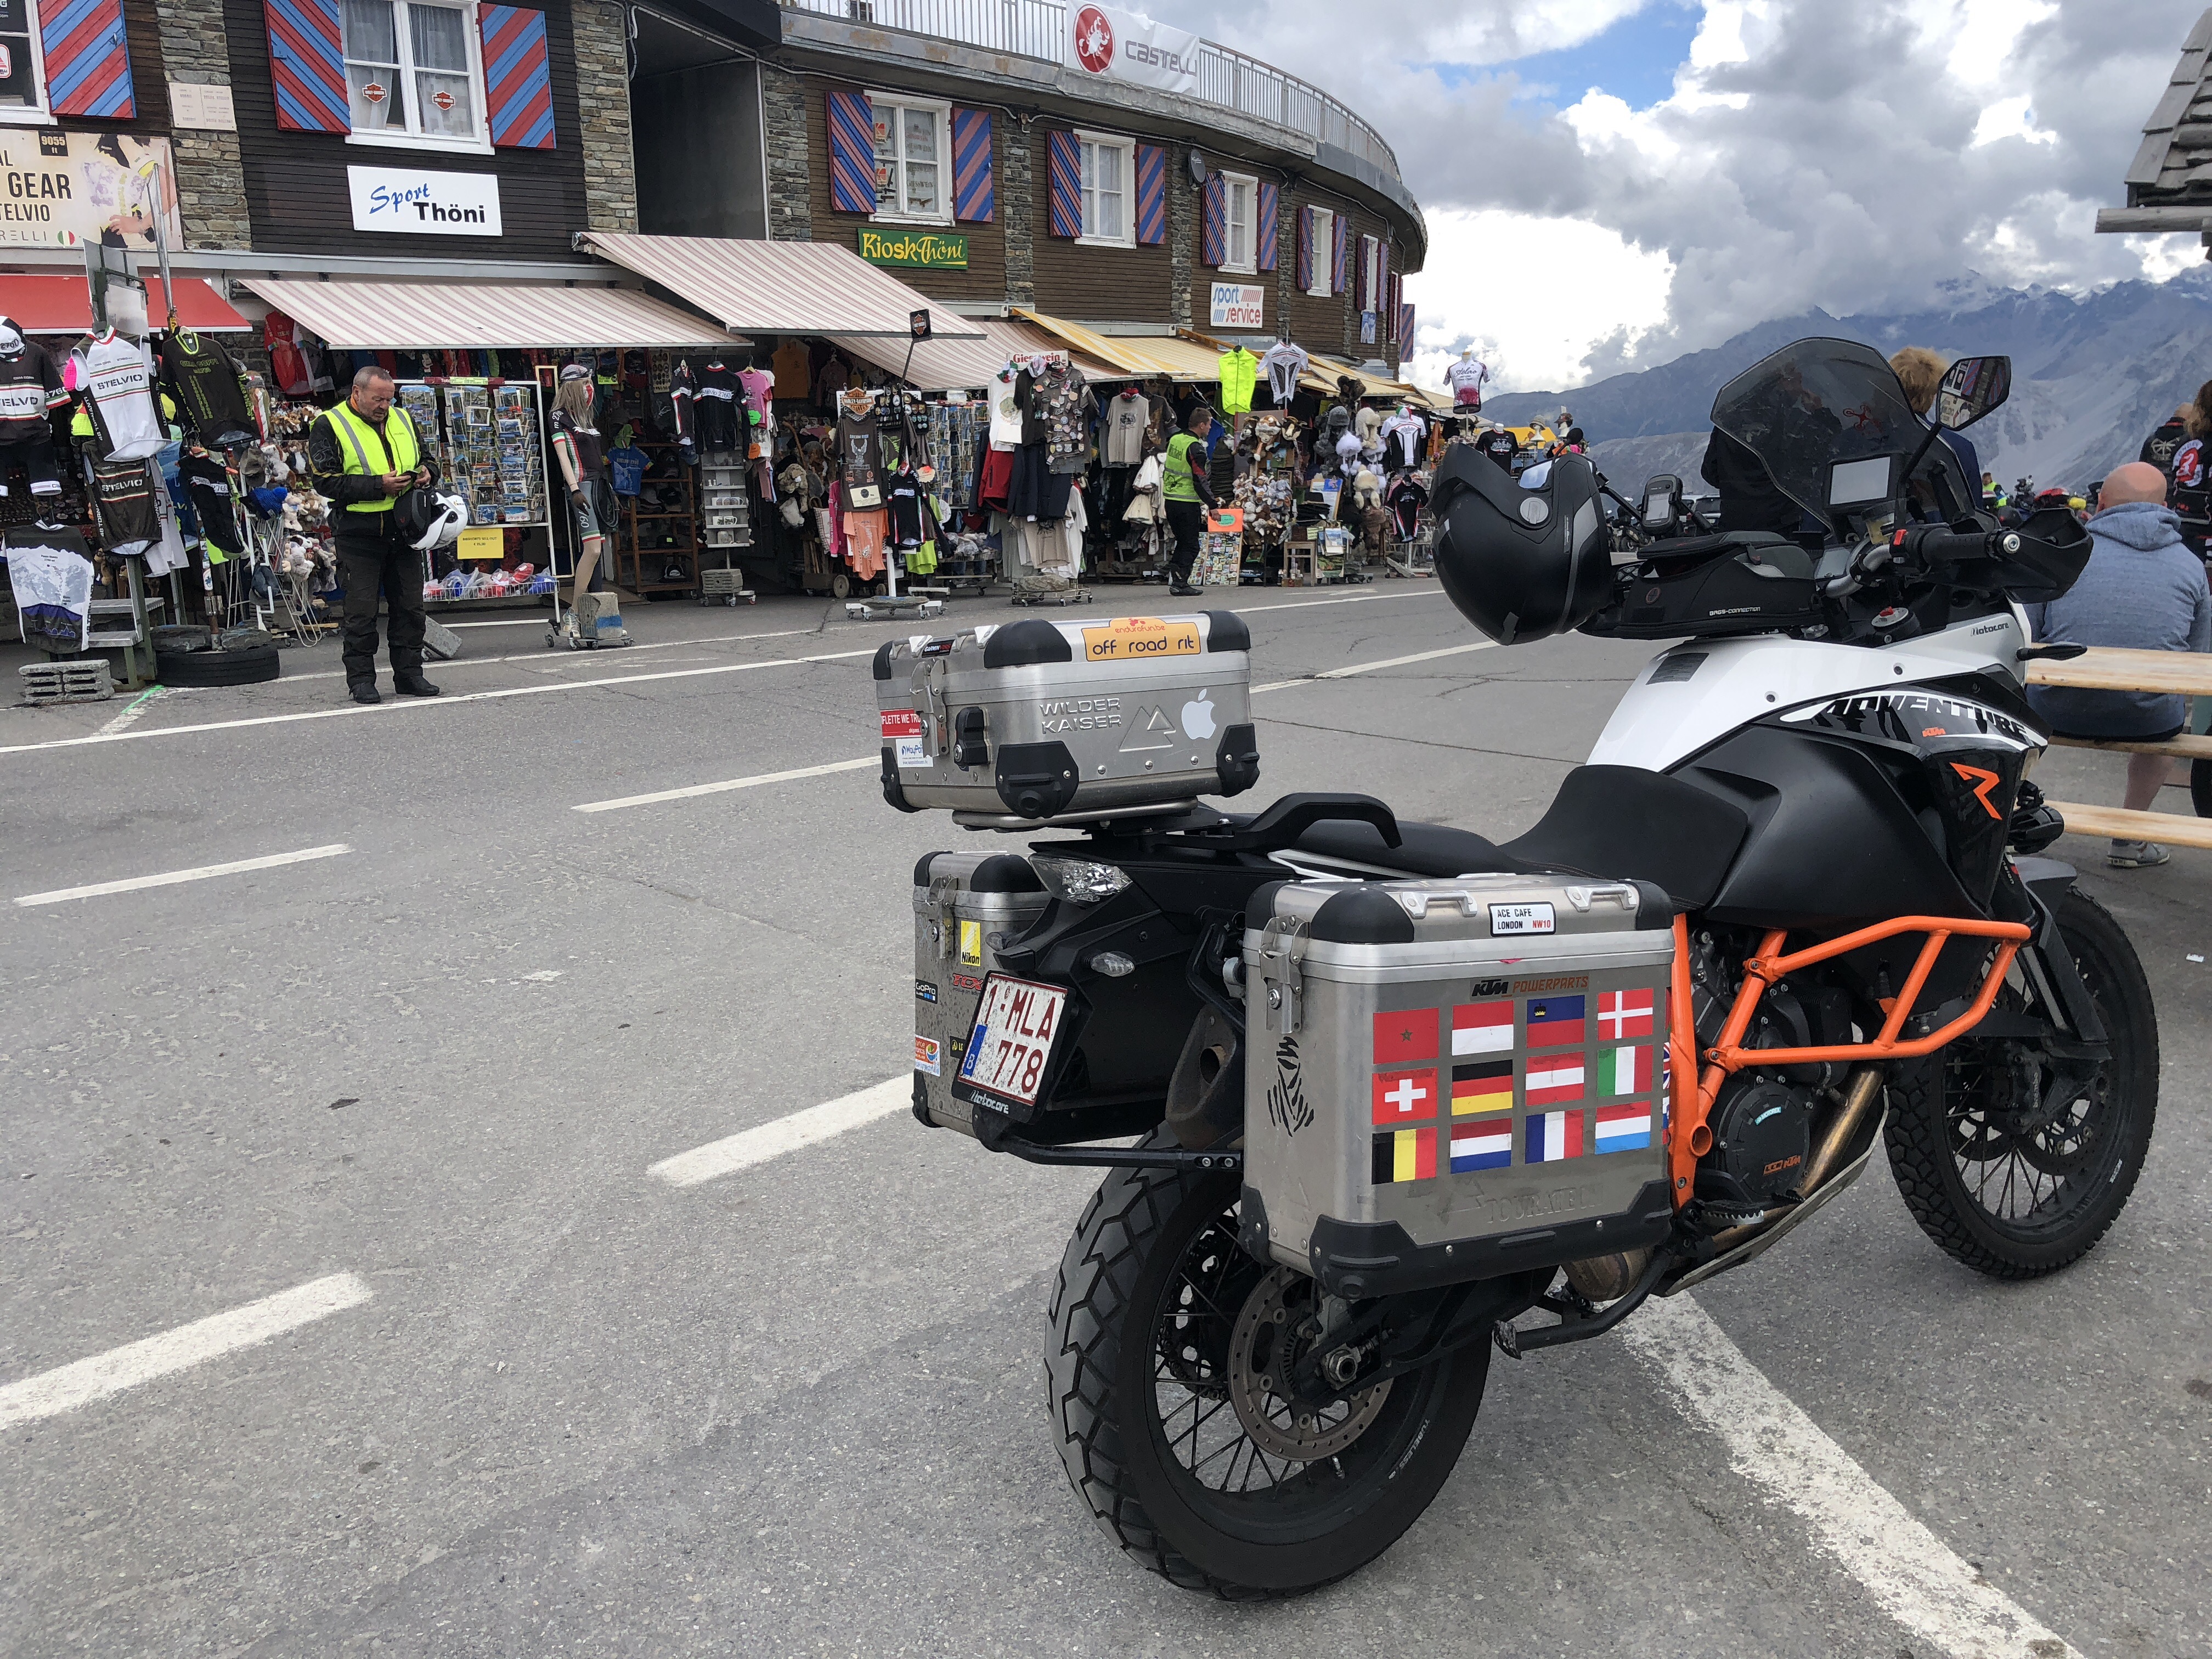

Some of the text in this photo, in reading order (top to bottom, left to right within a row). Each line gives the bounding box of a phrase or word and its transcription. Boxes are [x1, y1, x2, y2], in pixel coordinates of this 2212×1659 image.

[42, 136, 65, 146] 9055
[8, 172, 72, 200] GEAR
[369, 183, 431, 215] Sport
[413, 201, 486, 223] Thöni
[862, 233, 966, 264] Kiosk Thöni
[1212, 285, 1239, 306] sport
[1226, 303, 1261, 324] service
[1013, 352, 1060, 364] Giesein
[97, 374, 143, 390] STELVIO
[101, 478, 143, 492] STELVIO
[1115, 624, 1166, 634] endurofun.be
[1092, 639, 1117, 655] off
[1128, 636, 1167, 653] road
[1039, 698, 1121, 717] WILDER
[1822, 693, 2030, 740] ADVENTURE
[901, 714, 910, 724] WE
[1041, 714, 1122, 735] KAISER
[1922, 727, 1946, 738] KTM
[1497, 908, 1532, 918] ACE CAFE
[1497, 919, 1551, 930] LONDON NW10
[961, 951, 980, 964] Nikon
[916, 981, 936, 995] GoPro
[952, 972, 984, 991] TCX
[1471, 975, 1589, 997] KTM POWERPARTS
[984, 984, 1057, 1042] 1-MLA
[966, 1053, 975, 1069] B
[992, 1039, 1043, 1093] 778
